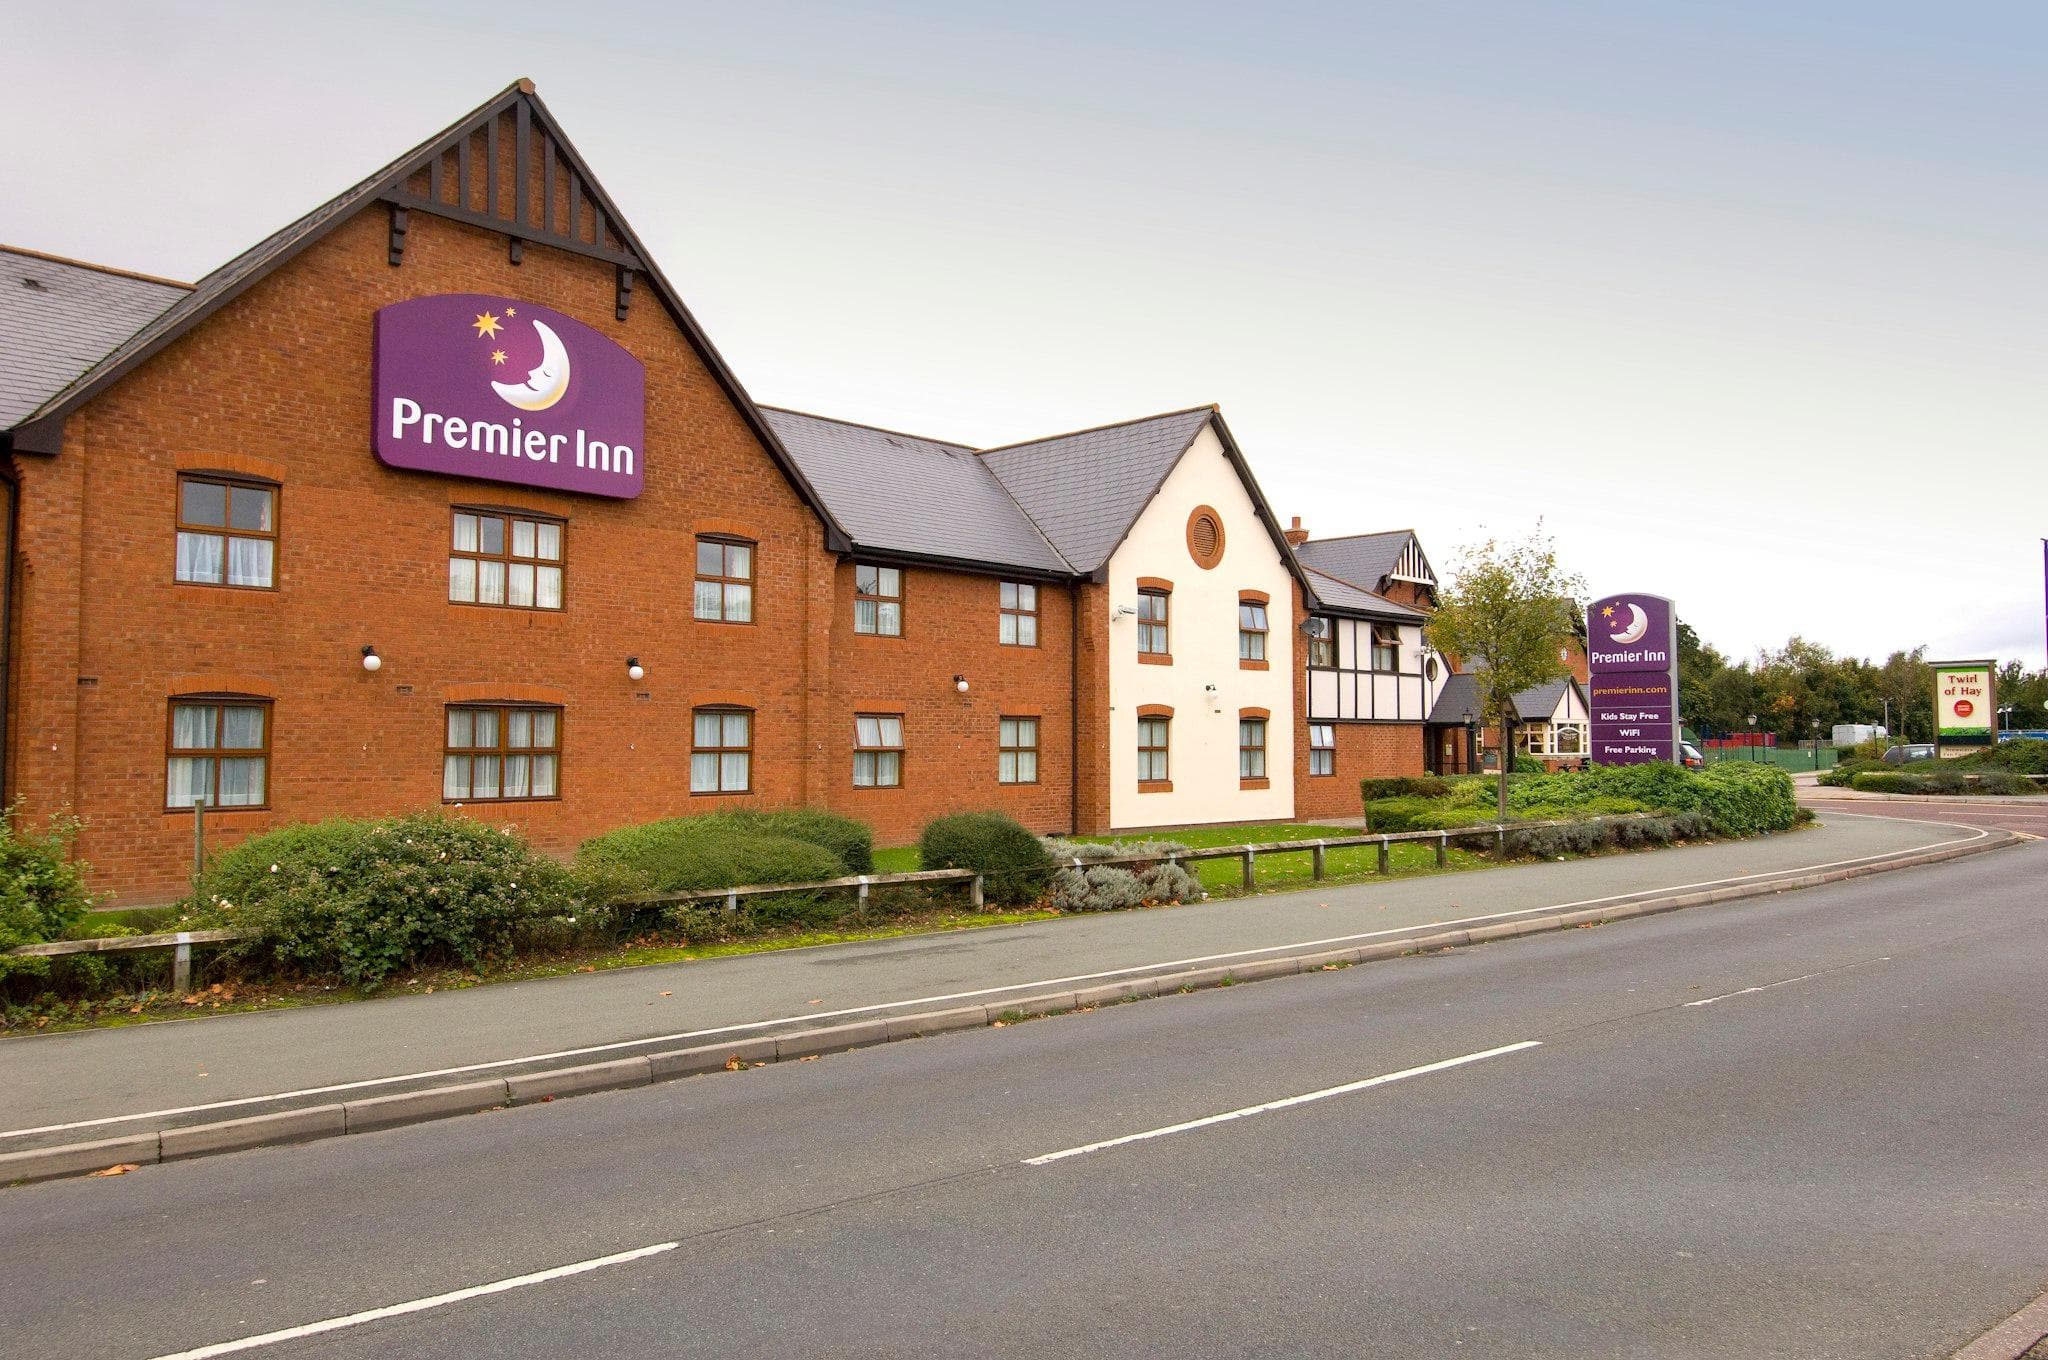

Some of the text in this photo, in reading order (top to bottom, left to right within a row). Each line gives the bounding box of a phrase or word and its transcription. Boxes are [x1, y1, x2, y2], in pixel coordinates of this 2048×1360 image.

[392, 397, 634, 475] Premier Inn
[1591, 649, 1666, 664] Premier Inn
[1948, 674, 1978, 683] Twirl
[1593, 686, 1667, 696] premierinn.com
[1944, 686, 1982, 696] of Hay
[1619, 712, 1637, 721] Stay
[1639, 712, 1659, 720] Free
[1604, 745, 1657, 755] Free Parking
